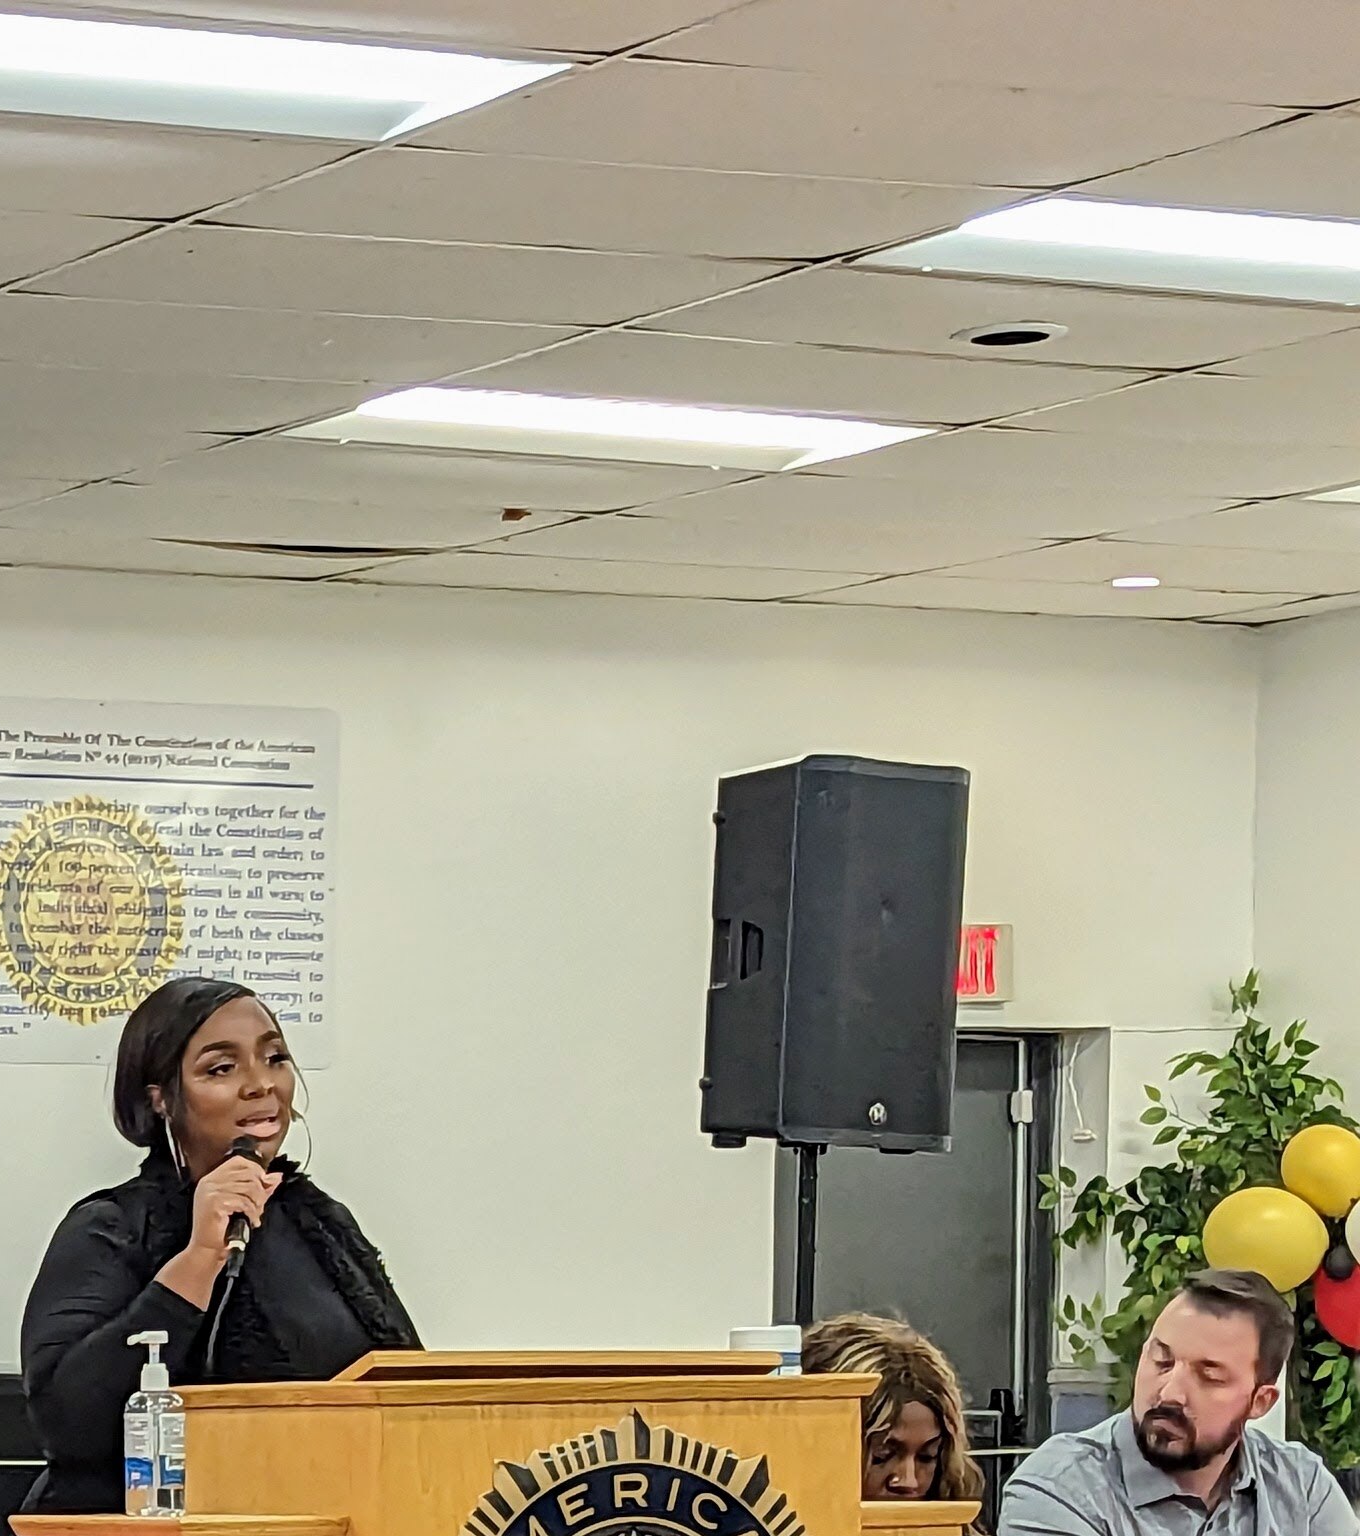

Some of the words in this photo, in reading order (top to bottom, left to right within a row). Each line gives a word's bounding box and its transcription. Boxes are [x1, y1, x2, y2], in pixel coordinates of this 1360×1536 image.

[215, 805, 274, 820] together
[304, 807, 326, 820] the
[189, 822, 212, 835] the
[311, 850, 324, 861] to
[310, 890, 324, 901] to
[194, 906, 208, 918] to
[215, 905, 237, 918] the
[249, 927, 272, 940] the
